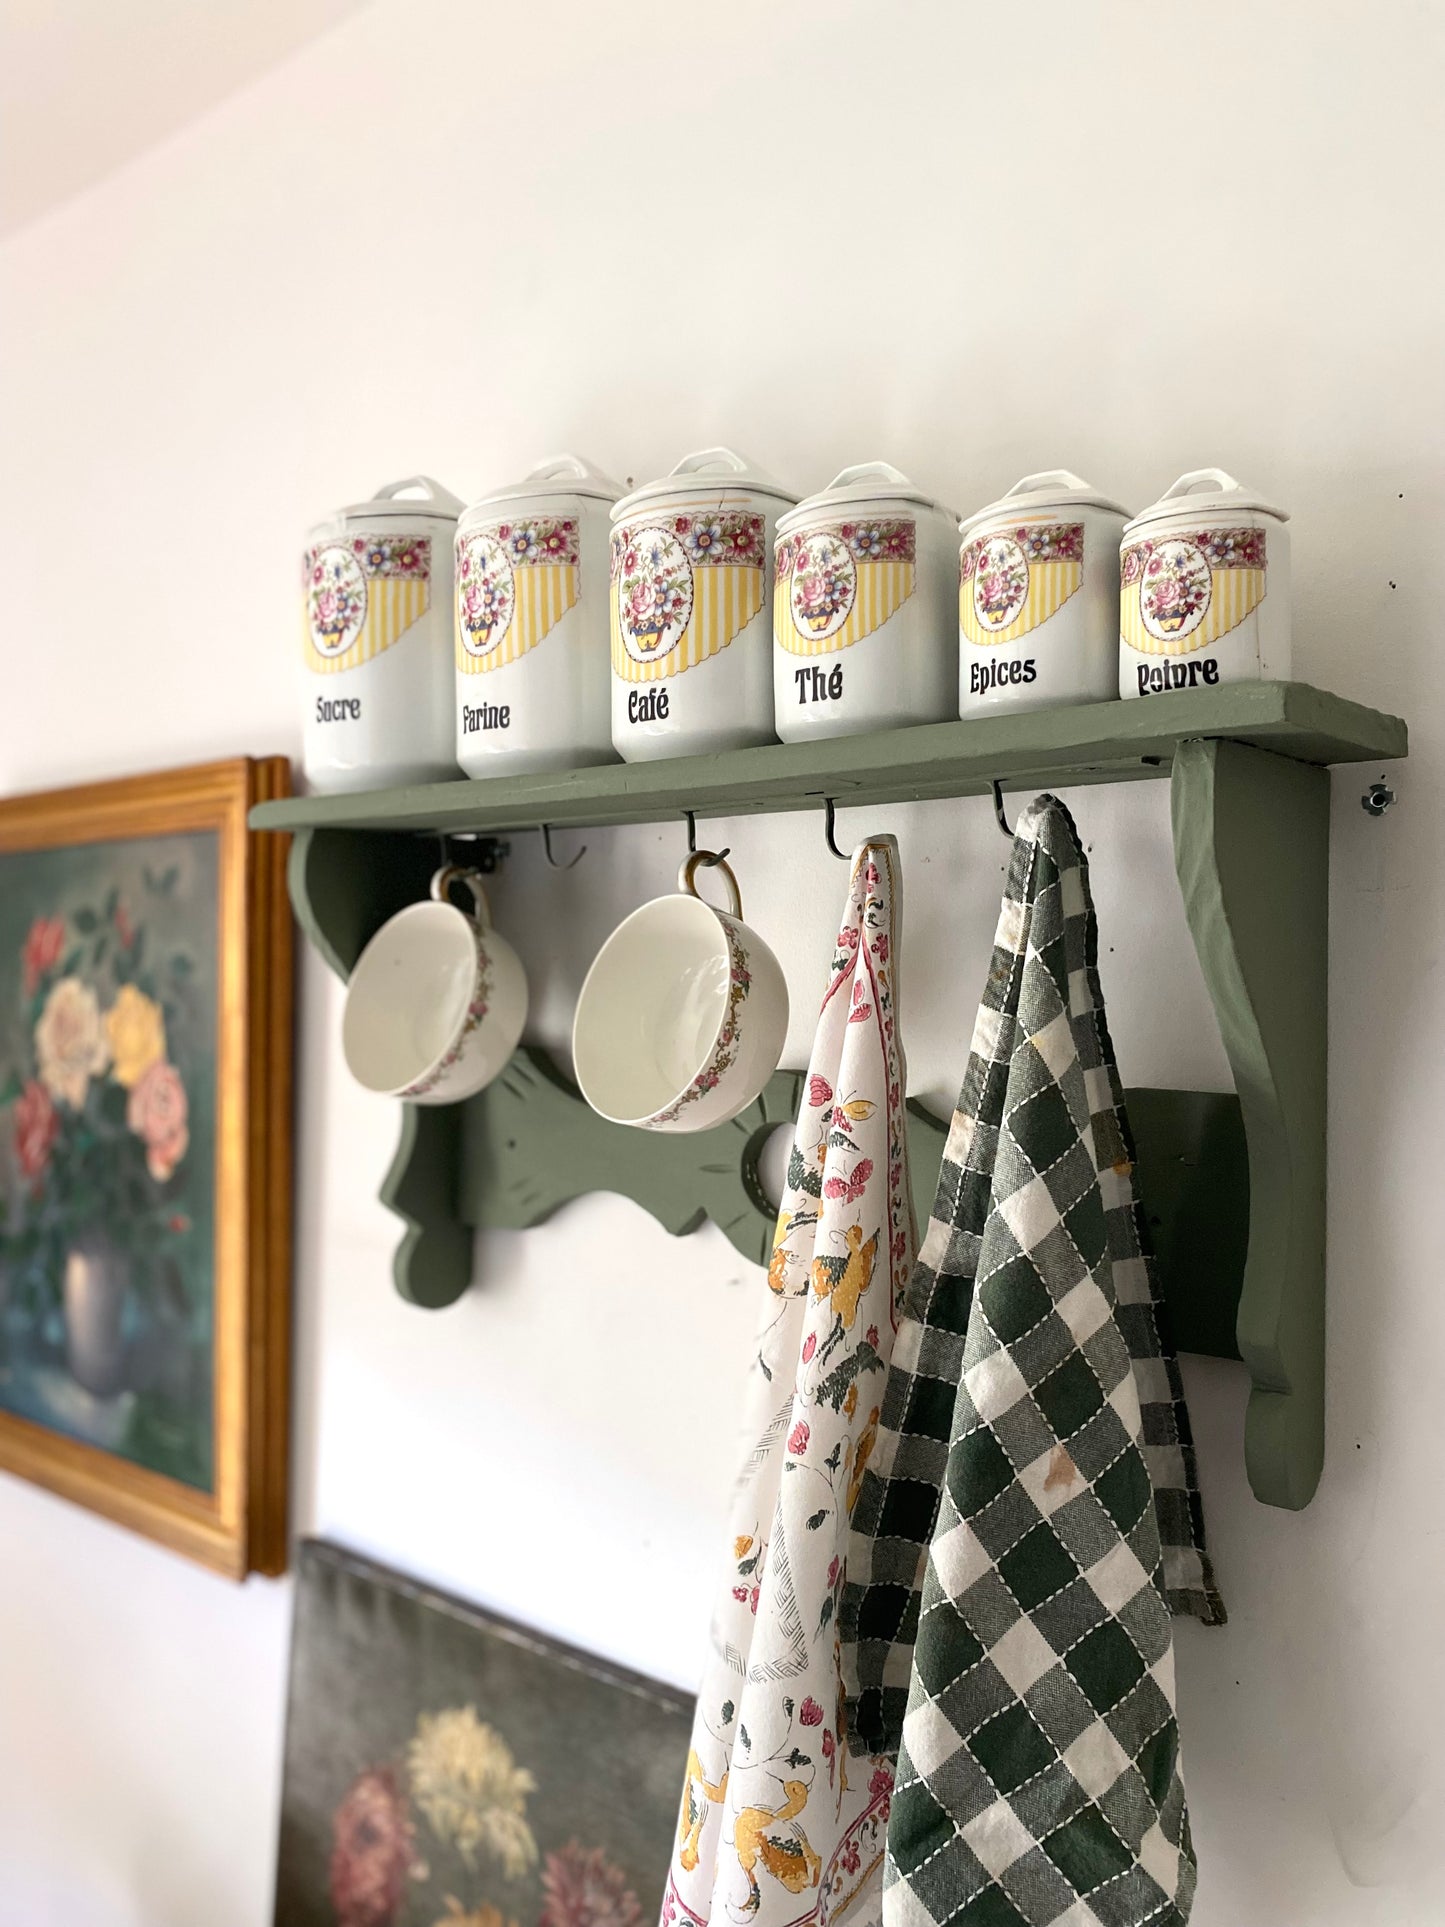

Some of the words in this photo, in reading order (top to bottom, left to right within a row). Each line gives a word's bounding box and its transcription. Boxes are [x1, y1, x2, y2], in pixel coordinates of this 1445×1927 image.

[794, 663, 843, 705] Thé
[970, 658, 1037, 695] Epices
[1137, 658, 1219, 697] Poivre
[317, 697, 361, 723] Sucre
[463, 702, 510, 734] Farine
[628, 687, 669, 724] Café
